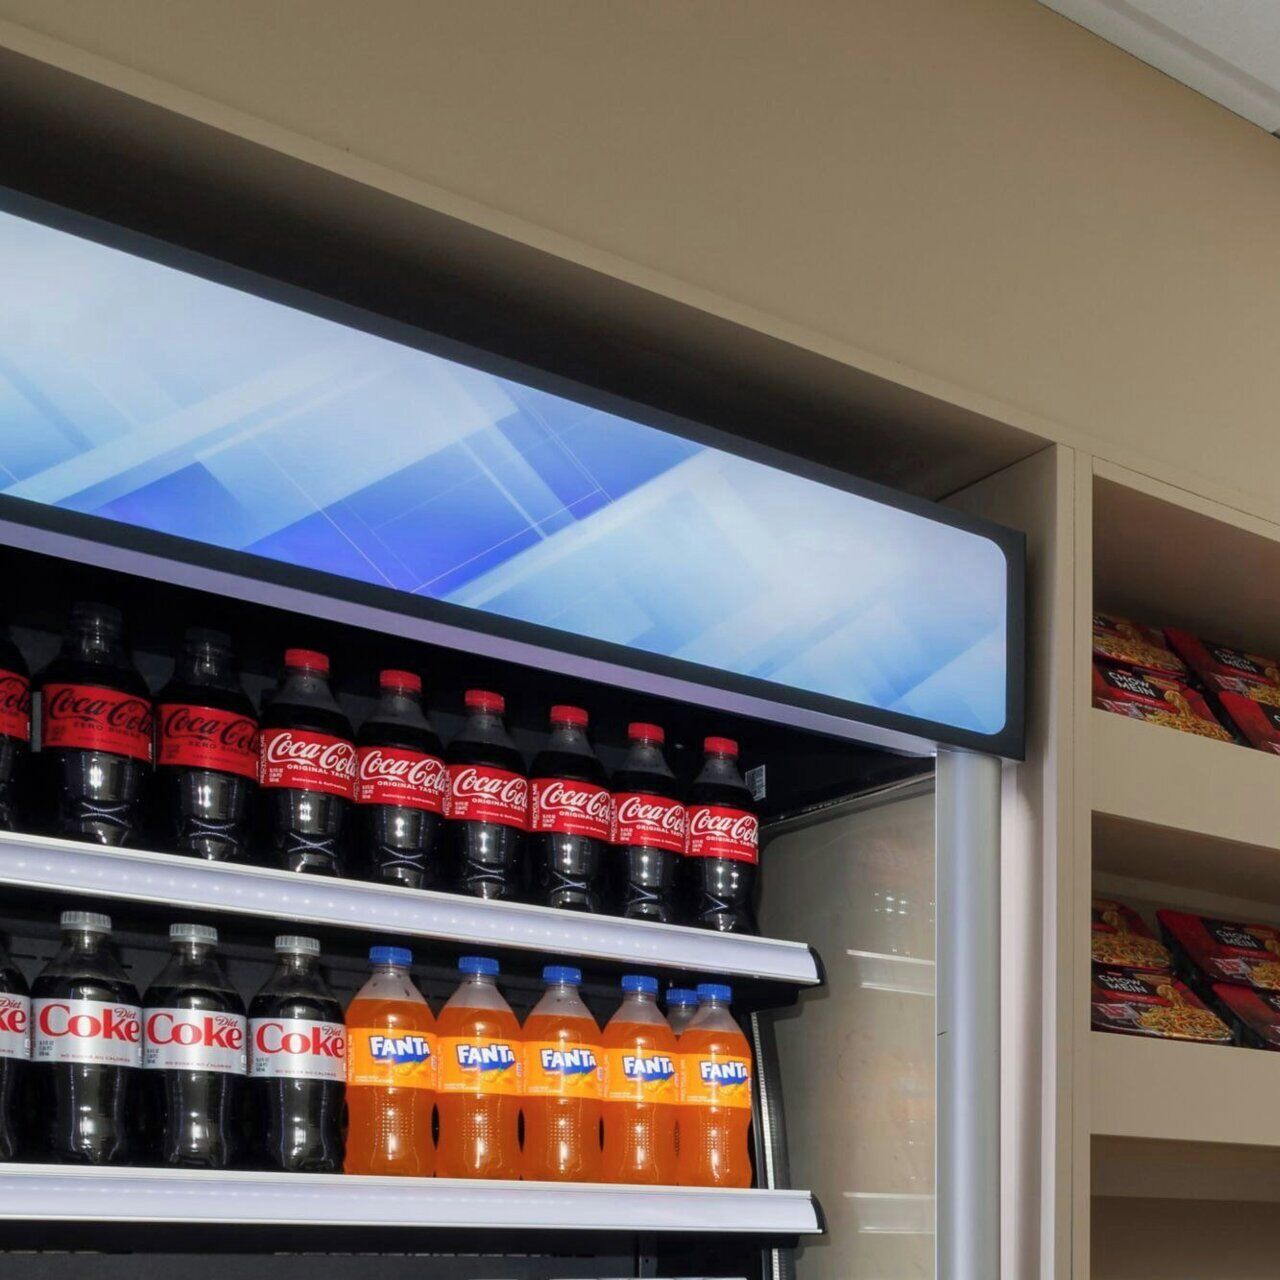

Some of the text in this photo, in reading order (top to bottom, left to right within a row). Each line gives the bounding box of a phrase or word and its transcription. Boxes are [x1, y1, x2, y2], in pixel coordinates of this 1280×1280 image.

[1108, 671, 1150, 688] CHOW
[1115, 681, 1157, 698] MEIN
[286, 763, 329, 775] ORIGINAL
[377, 780, 417, 790] ORIGINAL
[471, 797, 509, 808] ORIGINAL
[1224, 937, 1258, 949] MEIN
[1098, 974, 1142, 988] CHOW
[1107, 982, 1148, 994] MEIN
[113, 1007, 137, 1020] Diet
[215, 1015, 239, 1028] Diet
[39, 1004, 141, 1043] Coke
[146, 1013, 243, 1050] Coke
[322, 1024, 342, 1037] Diet
[256, 1023, 345, 1059] Coke
[370, 1036, 431, 1057] FANTA
[457, 1044, 516, 1065] FANTA
[541, 1048, 597, 1069] FANTA
[623, 1056, 675, 1075] FANTA
[700, 1062, 748, 1079] FANTA
